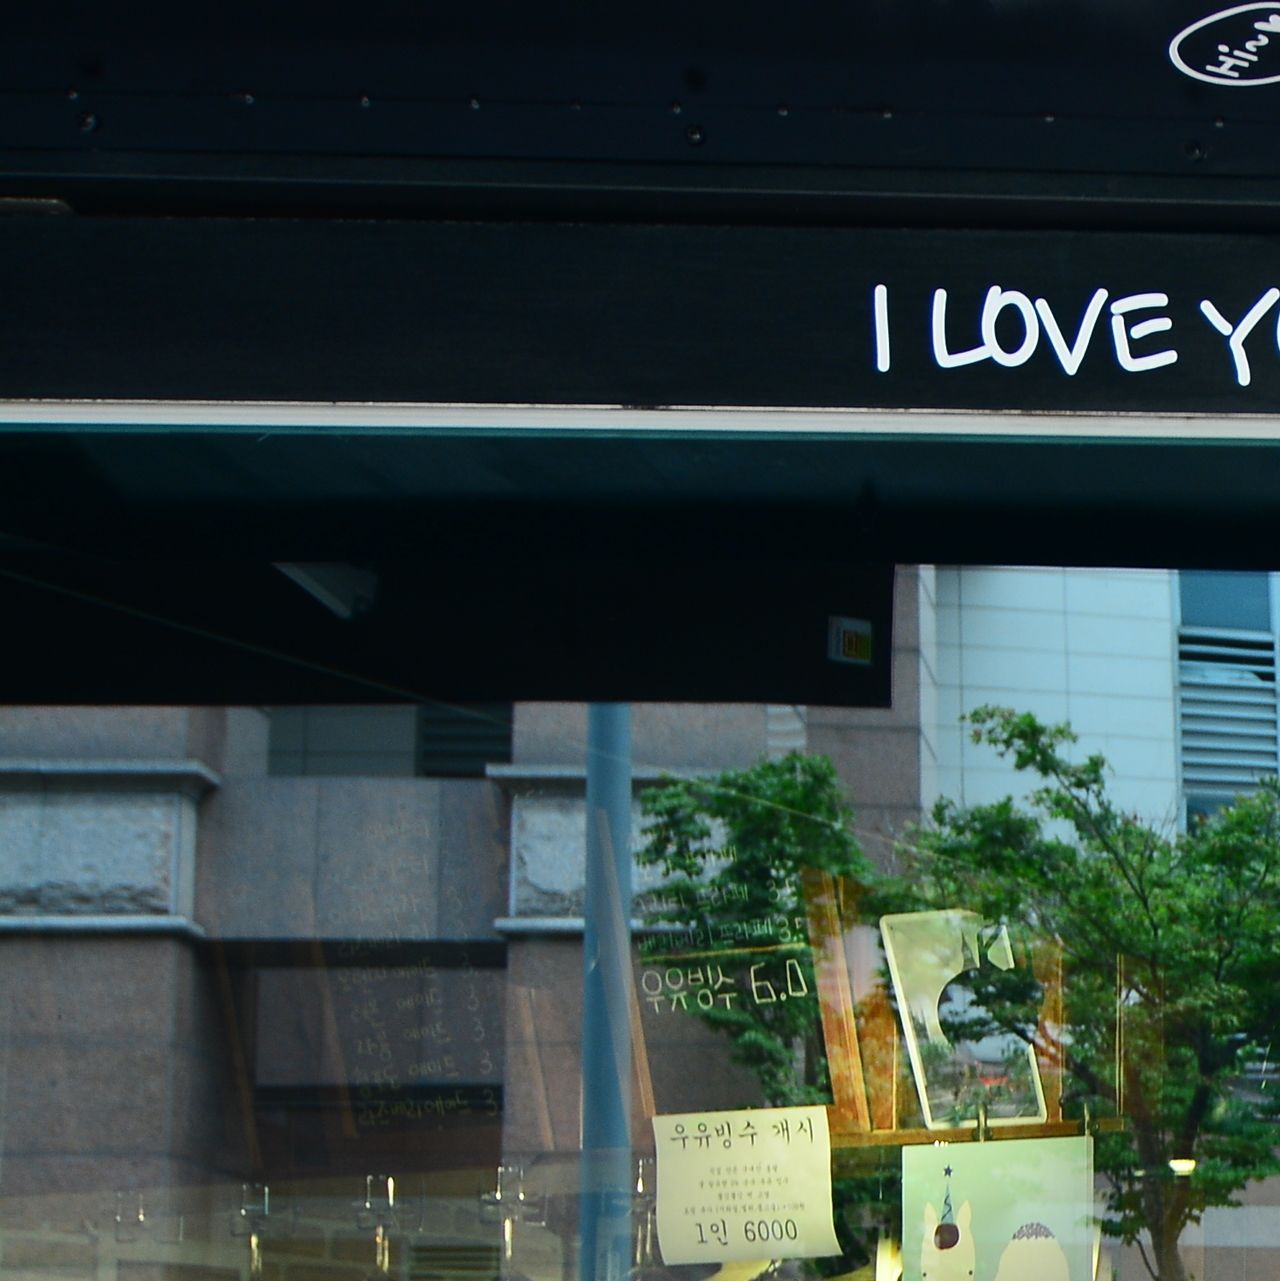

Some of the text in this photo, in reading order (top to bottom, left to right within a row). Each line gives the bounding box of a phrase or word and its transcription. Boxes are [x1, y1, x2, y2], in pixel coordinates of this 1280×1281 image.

[874, 284, 890, 372] I
[932, 284, 1178, 376] LOVE
[641, 962, 739, 1014] 우유빙수
[668, 1116, 815, 1151] 우유빙수 개시
[695, 1217, 799, 1248] 1인 6000
